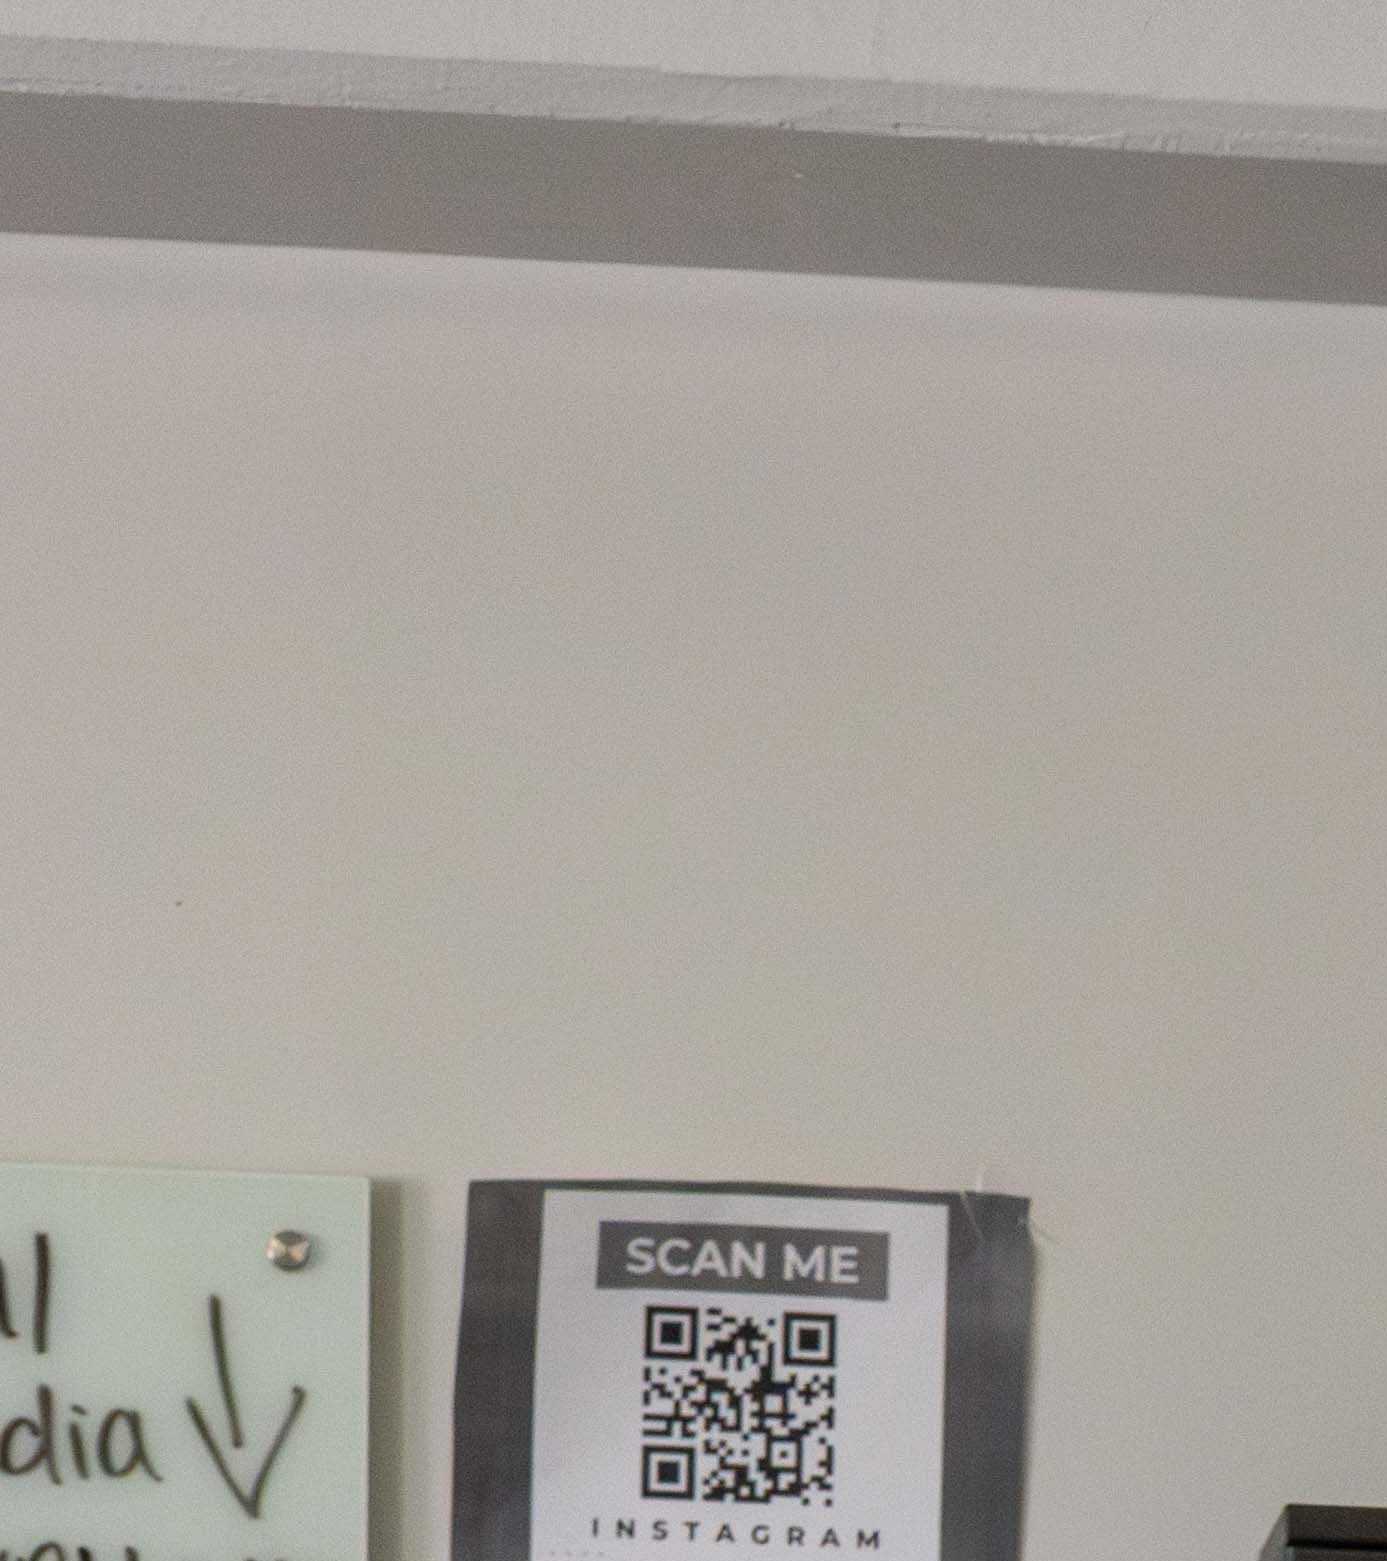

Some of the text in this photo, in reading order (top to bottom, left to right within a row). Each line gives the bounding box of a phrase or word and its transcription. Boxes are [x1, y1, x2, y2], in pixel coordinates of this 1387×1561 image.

[626, 1236, 860, 1285] SCAN ME
[0, 1232, 50, 1355] l
[591, 1517, 881, 1549] INSTAGRAM
